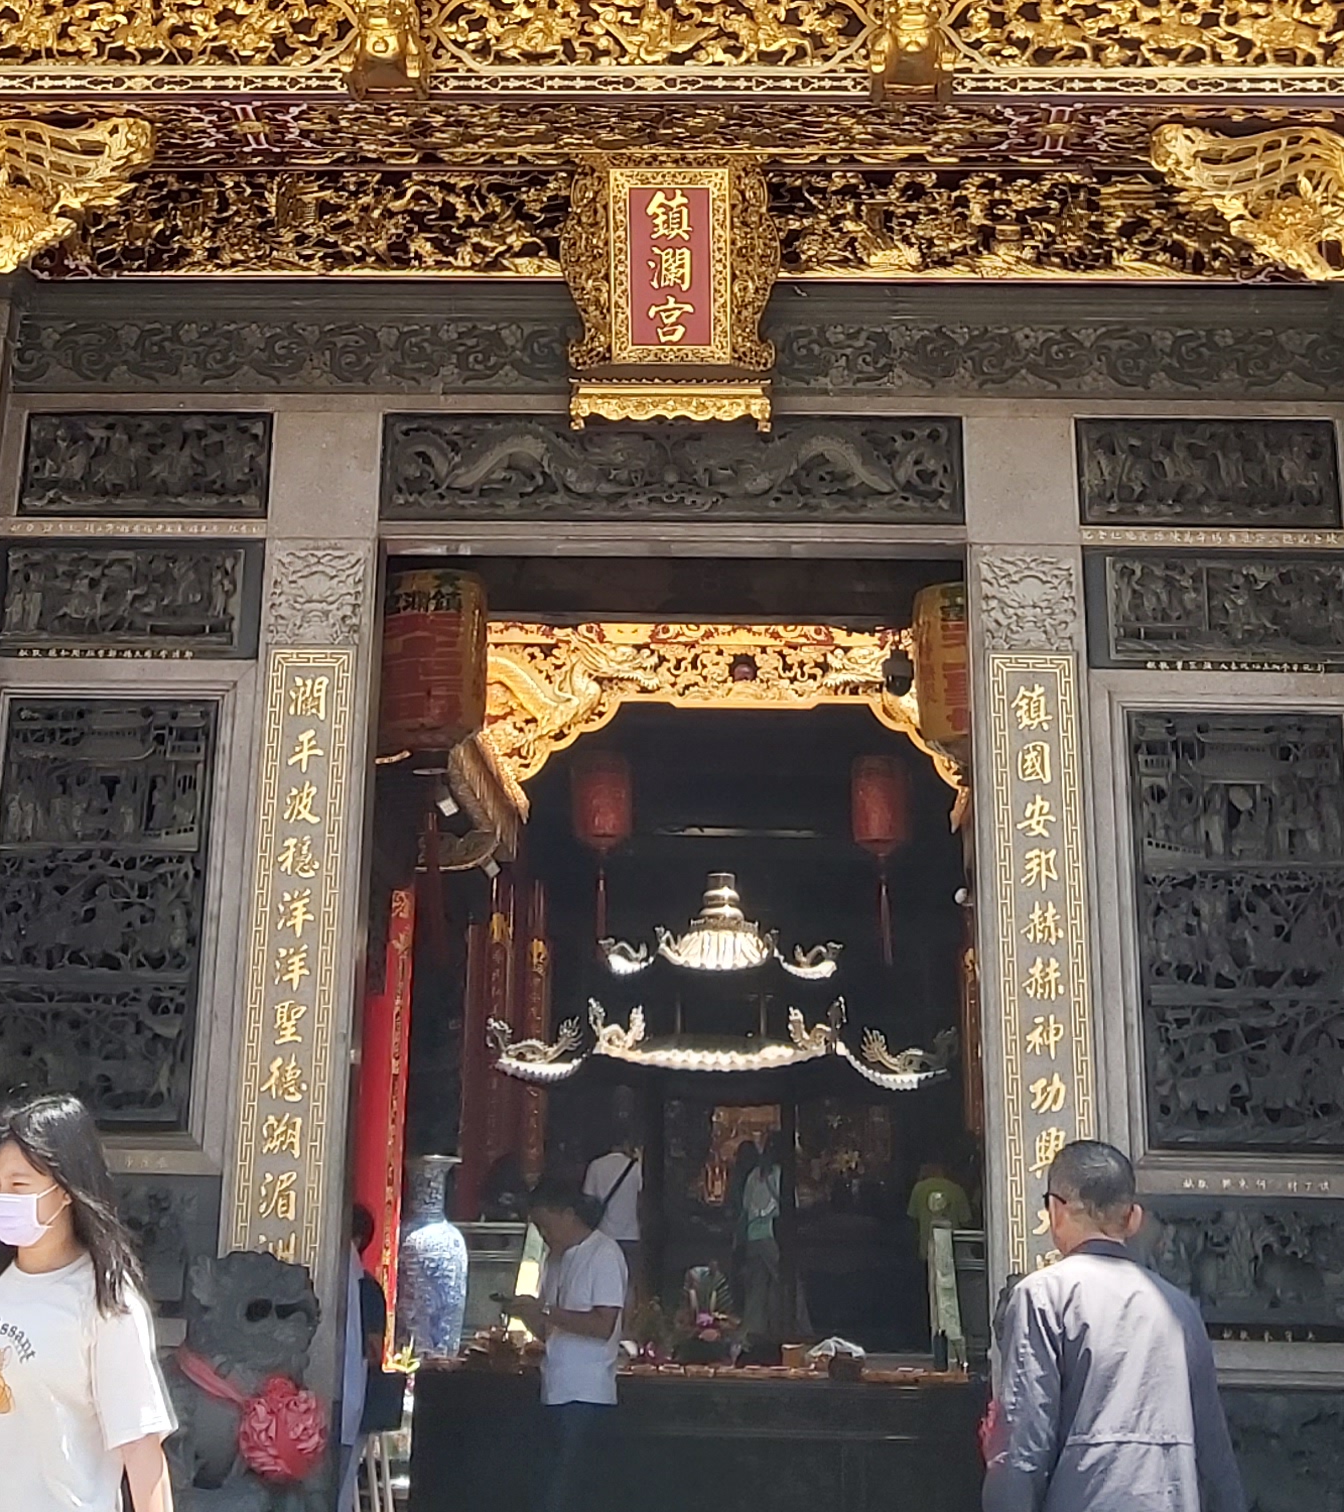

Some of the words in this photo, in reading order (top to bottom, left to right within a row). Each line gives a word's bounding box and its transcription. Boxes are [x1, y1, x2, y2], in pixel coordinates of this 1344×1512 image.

[645, 188, 694, 344] 鎮瀾宮
[1010, 683, 1067, 1269] 鎮國安邦赫赫神功興
